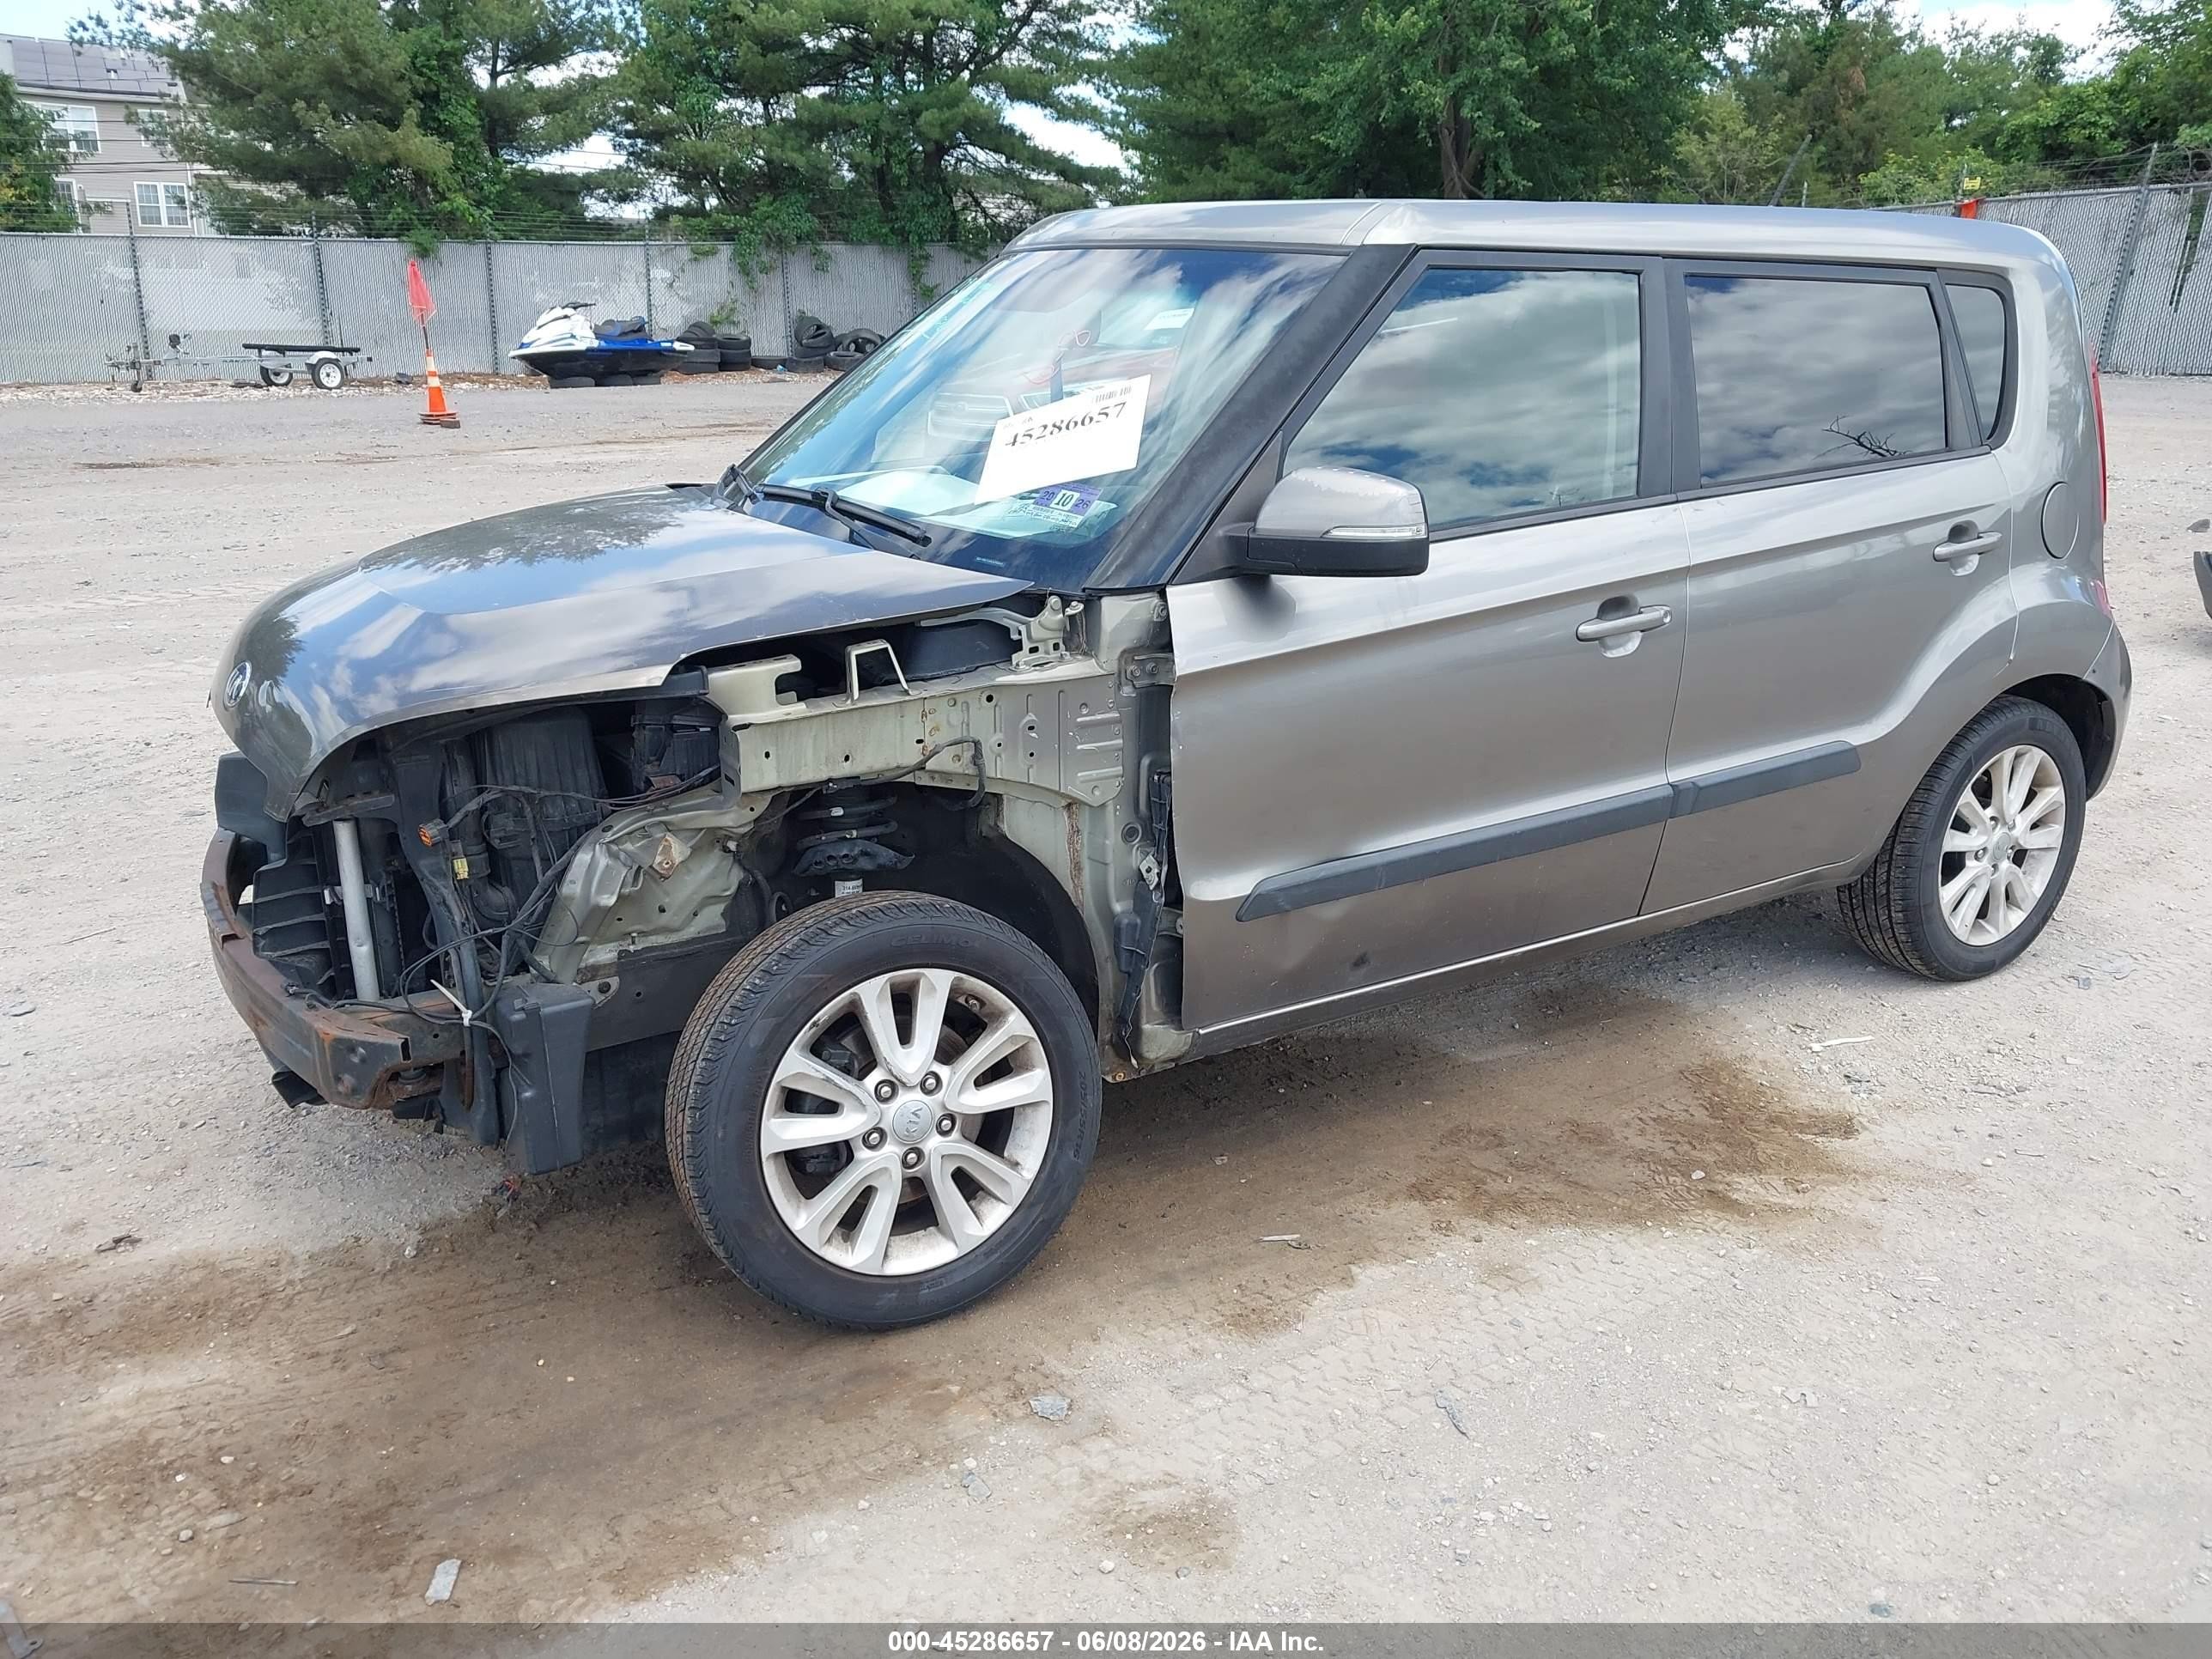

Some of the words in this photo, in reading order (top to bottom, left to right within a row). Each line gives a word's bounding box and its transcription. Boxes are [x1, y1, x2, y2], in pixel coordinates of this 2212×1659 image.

[1005, 401, 1127, 447] 45286657
[1042, 490, 1055, 501] 20
[1054, 492, 1074, 507] 10
[1074, 498, 1091, 509] 26
